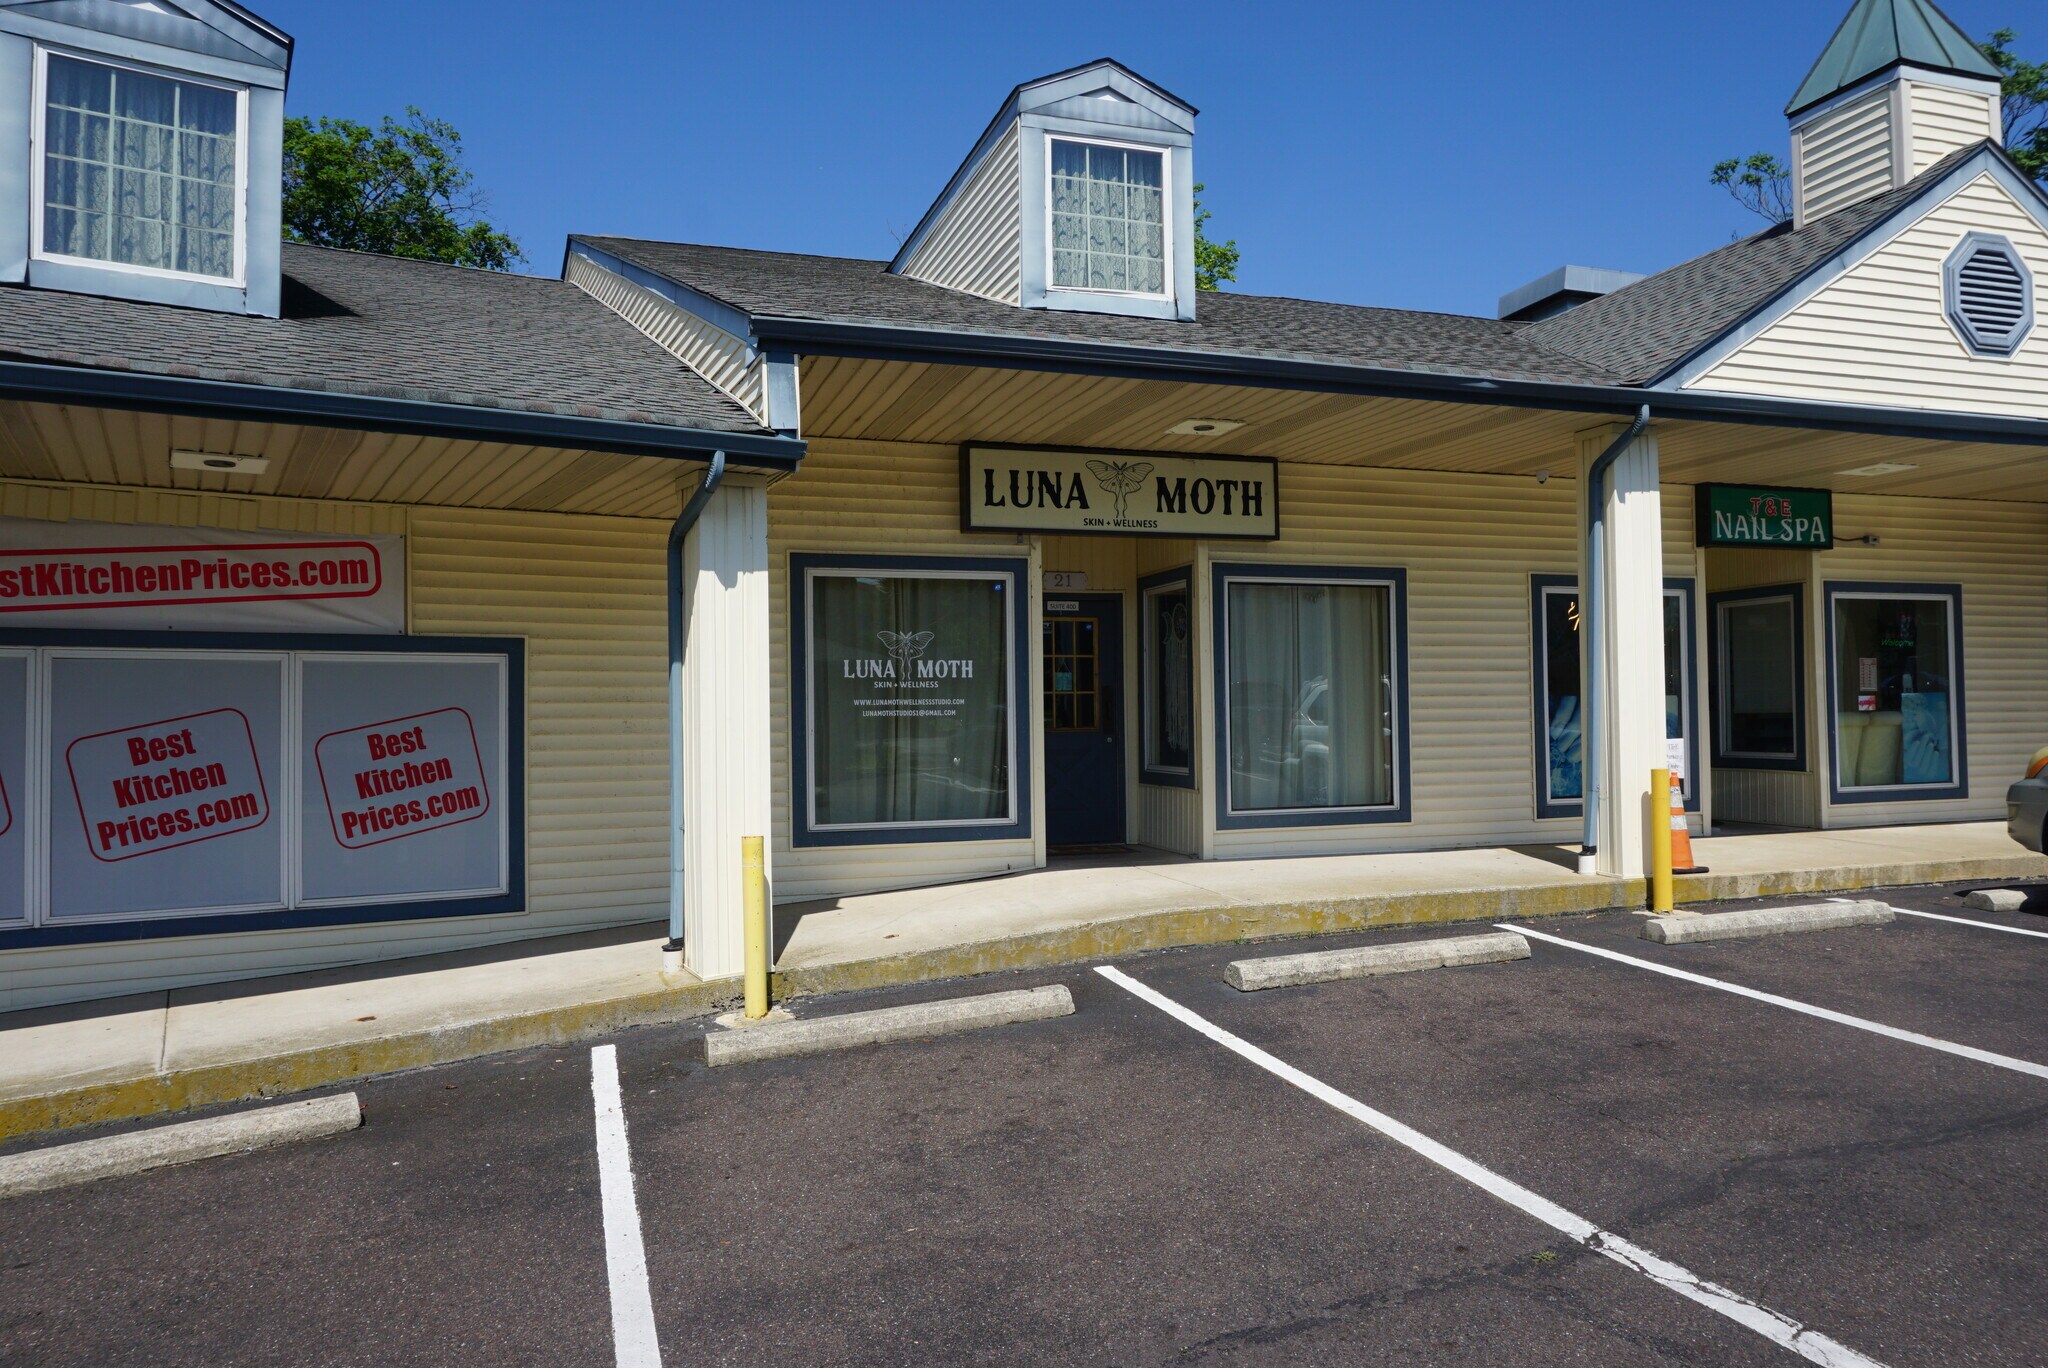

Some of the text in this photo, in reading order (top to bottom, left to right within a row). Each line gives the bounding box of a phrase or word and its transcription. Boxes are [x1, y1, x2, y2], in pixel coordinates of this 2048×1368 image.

[984, 468, 1263, 516] LUNA MOTH
[1750, 497, 1792, 516] T & E
[1083, 517, 1105, 527] SKIN
[1112, 518, 1158, 529] WELLNESS
[1715, 510, 1826, 543] NAIL SPA
[1054, 573, 1072, 587] 21
[843, 659, 974, 679] LUNA MOTH
[873, 681, 893, 689] SKIN
[899, 681, 939, 689] WELLNESS
[853, 698, 965, 706] WWW.LUNAMOTHWELLNESSSTUDIO.COM
[127, 728, 197, 767] Best
[367, 725, 427, 761] Best
[113, 761, 227, 808] Kitchen
[355, 757, 453, 800] Kitchen
[97, 791, 259, 851] Prices.com
[341, 784, 481, 839] Prices.com
